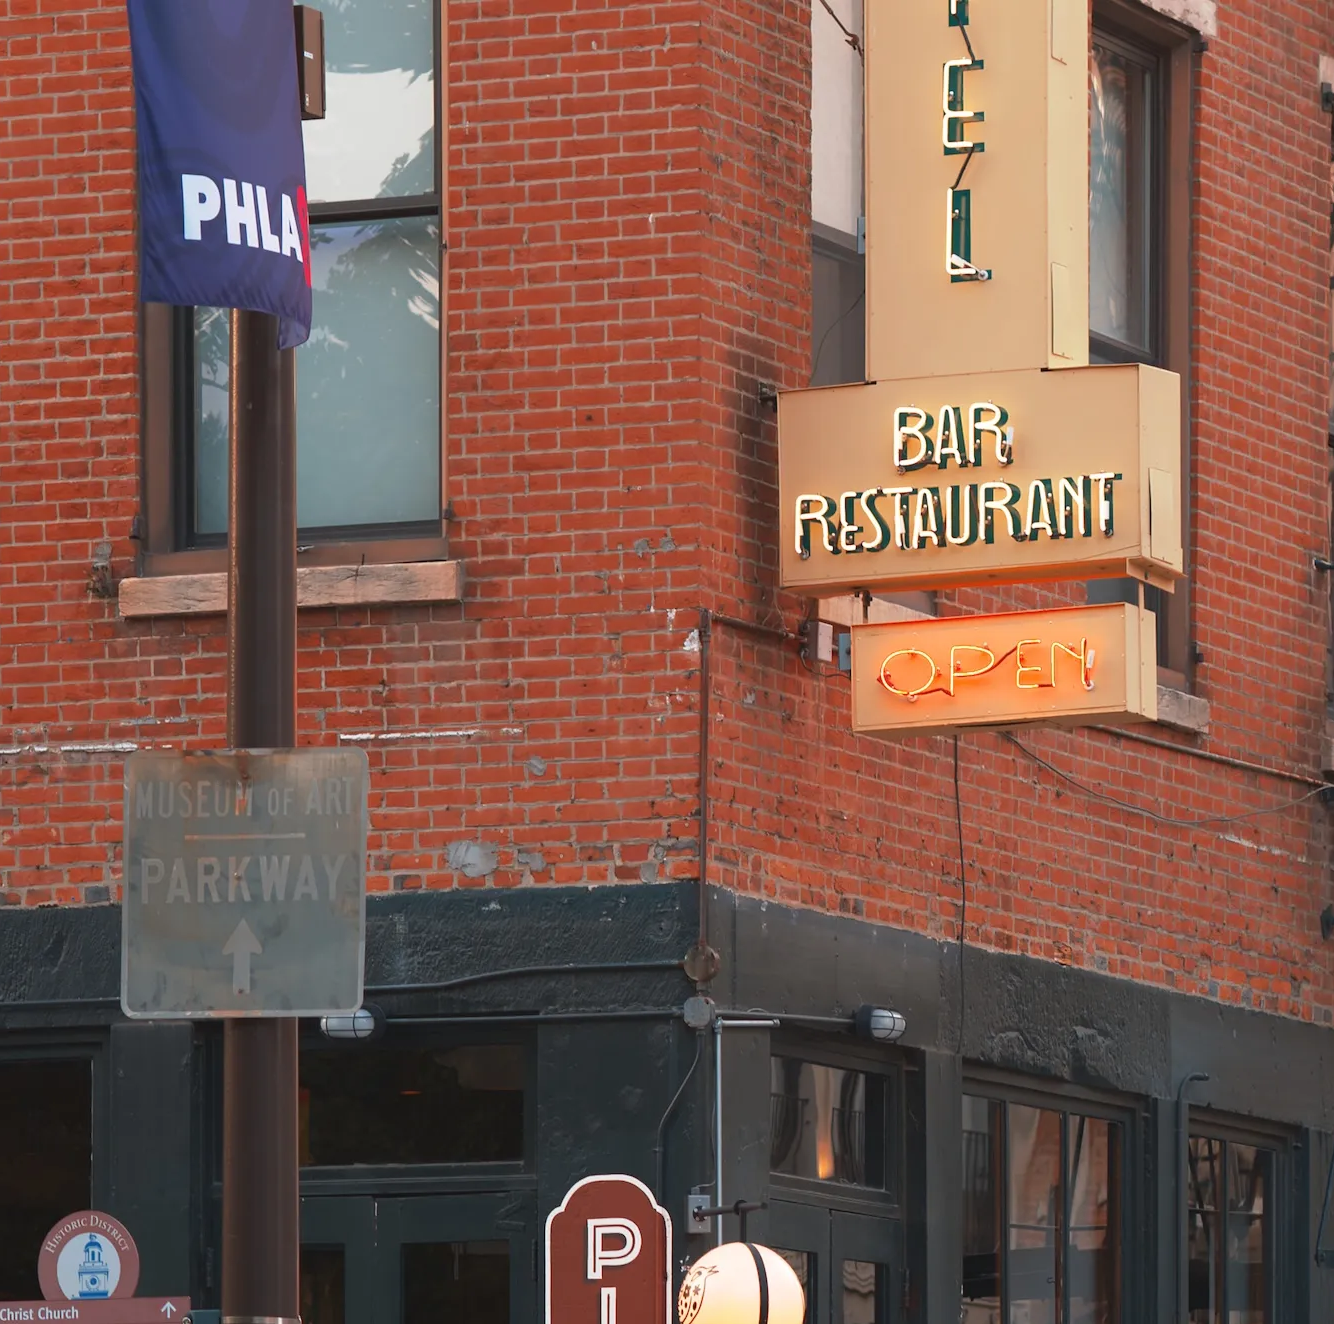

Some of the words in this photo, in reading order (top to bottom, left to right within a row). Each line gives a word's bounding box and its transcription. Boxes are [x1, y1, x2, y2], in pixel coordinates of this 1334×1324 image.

[941, 0, 993, 283] EL
[893, 401, 1014, 474] BAR
[794, 472, 1123, 561] RESTAURANT
[877, 638, 1096, 701] OPEN
[135, 780, 253, 819] MUSEUM
[268, 787, 295, 816] OF
[304, 777, 358, 816] ART
[141, 855, 347, 904] PARKWAY
[45, 1217, 88, 1253] HISTORIC
[90, 1214, 129, 1251] DISTRICT
[0, 1307, 34, 1321] Christ
[38, 1306, 79, 1320] Church
